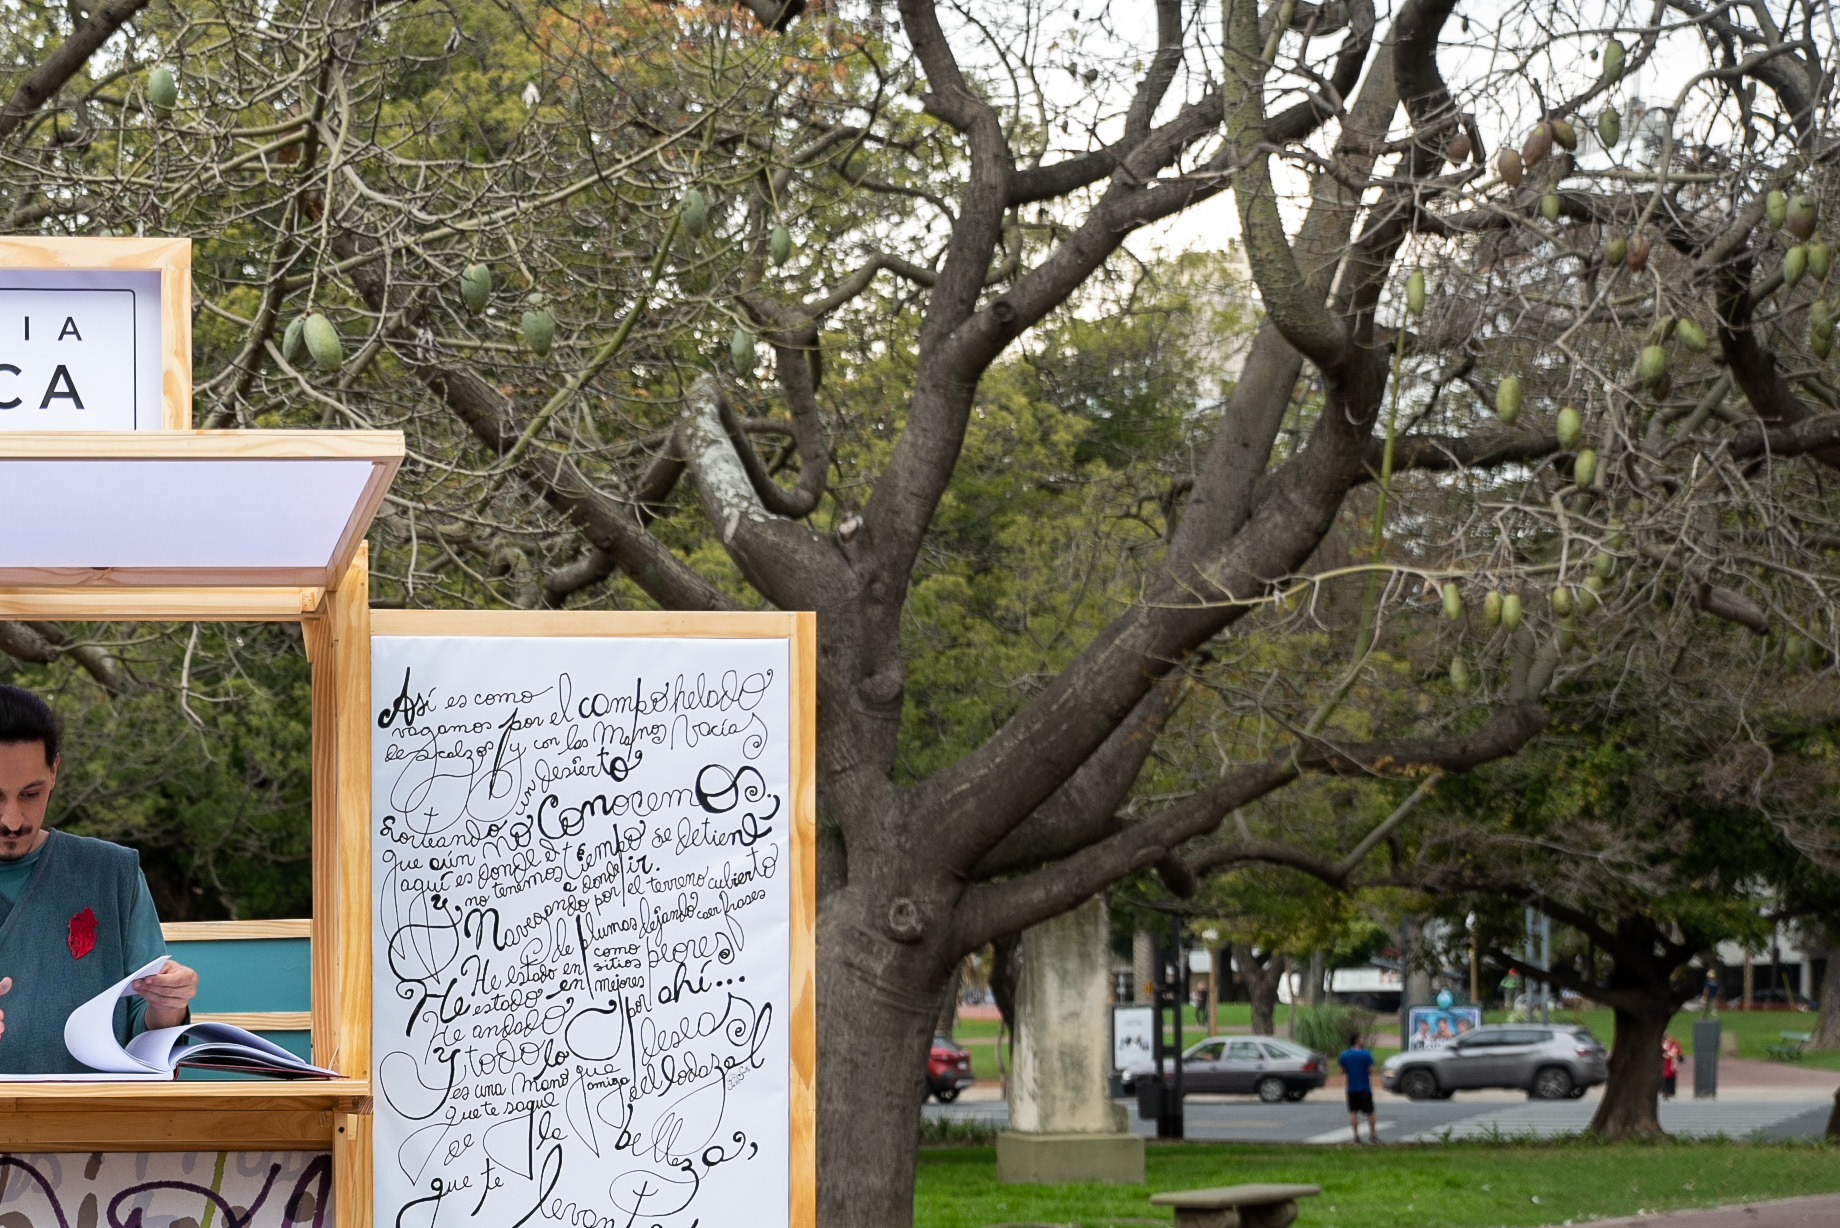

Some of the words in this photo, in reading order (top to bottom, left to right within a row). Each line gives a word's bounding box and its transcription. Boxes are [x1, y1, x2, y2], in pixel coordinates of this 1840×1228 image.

[378, 666, 437, 728] Así
[445, 695, 467, 709] es
[474, 686, 553, 705] como
[549, 672, 574, 725] el
[579, 677, 669, 762] campo
[669, 668, 774, 713] helado
[533, 736, 560, 750] con
[558, 724, 588, 755] las
[515, 779, 536, 815] un
[429, 850, 475, 870] aún
[455, 872, 472, 888] es
[478, 849, 541, 889] donde
[540, 838, 560, 863] el
[563, 820, 646, 907] tiempo
[651, 828, 672, 848] se
[675, 813, 772, 855] detiene
[465, 895, 490, 907] no
[492, 866, 563, 898] tenemos
[563, 881, 577, 892] a
[582, 861, 620, 893] donde
[626, 855, 660, 874] ir.
[594, 886, 621, 916] por
[628, 874, 645, 895] el
[646, 866, 709, 893] terreno
[708, 843, 779, 889] cubierto
[551, 917, 574, 963] de
[639, 892, 699, 947] dejando
[697, 907, 721, 920] caer
[719, 890, 766, 951] frases
[594, 944, 640, 957] como
[461, 955, 501, 996] He
[505, 955, 558, 987] estado
[563, 963, 585, 975] en
[593, 957, 641, 971] sitios
[647, 932, 735, 1006] peores
[472, 989, 543, 1016] estado
[546, 978, 585, 999] en
[422, 1011, 466, 1065] He
[473, 997, 574, 1039] andado
[465, 1038, 545, 1077] todo
[533, 1038, 569, 1080] lo
[641, 992, 755, 1066] deseas
[449, 1087, 469, 1100] es
[475, 1083, 506, 1098] una
[512, 1068, 569, 1095] mano
[481, 1101, 500, 1116] te
[629, 1064, 663, 1102] del
[444, 1134, 474, 1166] de
[536, 1111, 568, 1150] la
[471, 1158, 504, 1216] te
